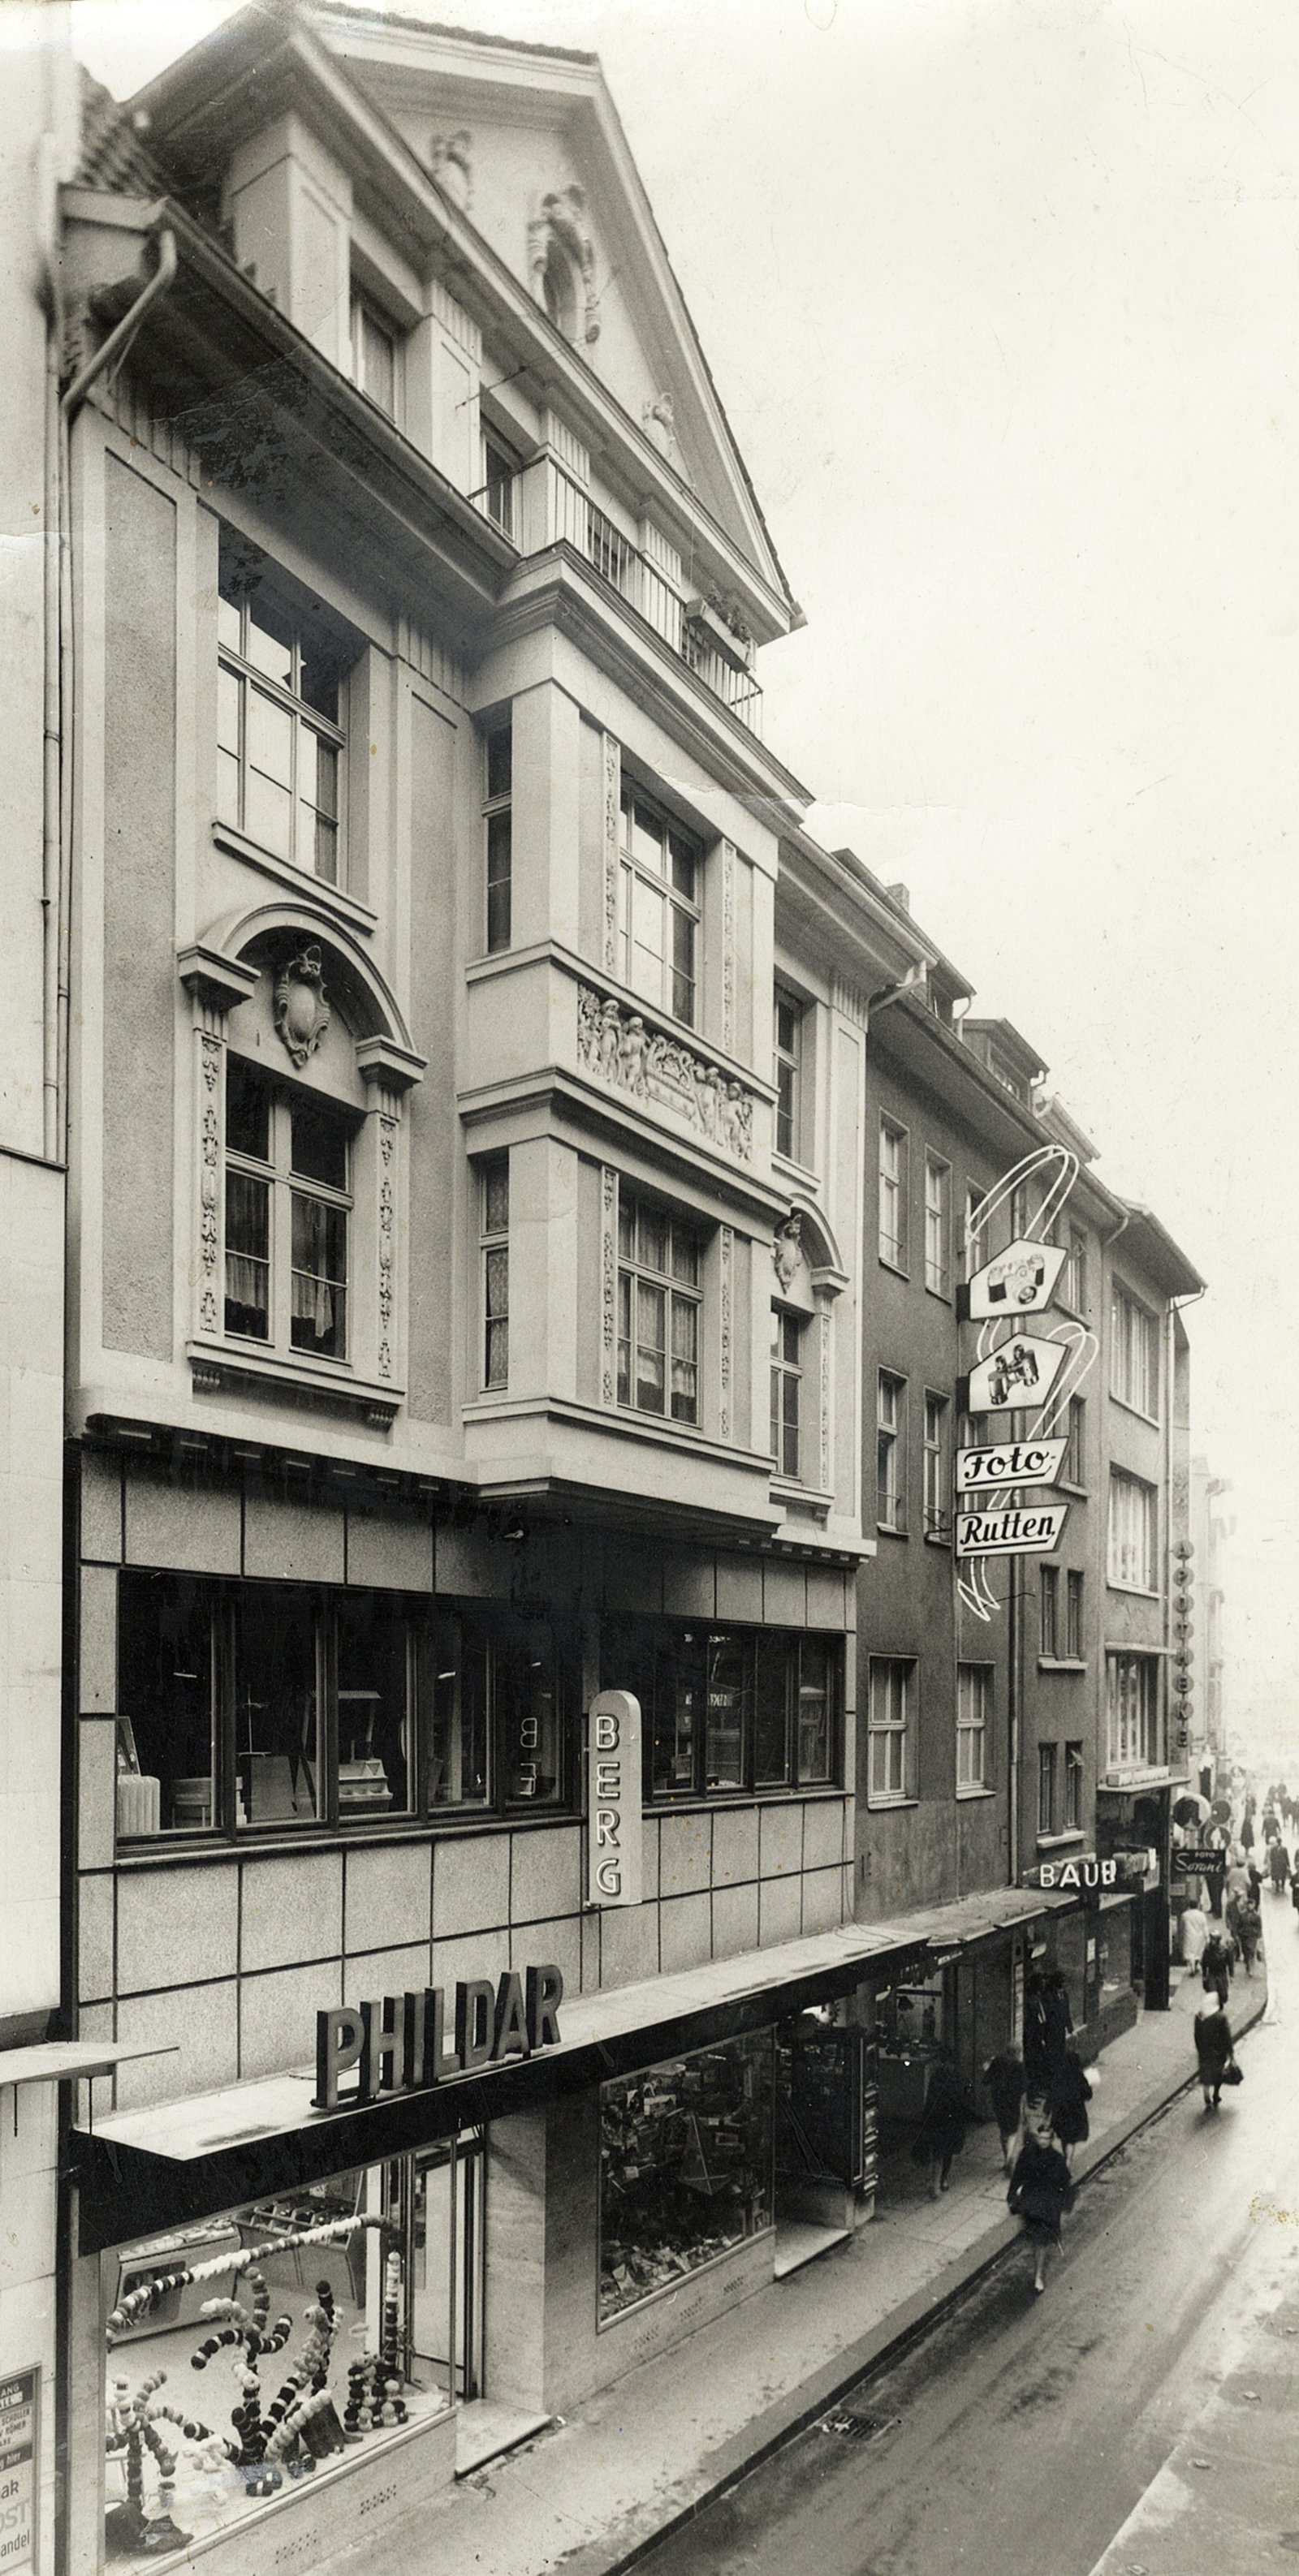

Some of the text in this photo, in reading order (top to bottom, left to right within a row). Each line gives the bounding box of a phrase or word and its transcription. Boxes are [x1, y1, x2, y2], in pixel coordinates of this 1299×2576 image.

[960, 1512, 1055, 1545] Rutten
[596, 1715, 620, 1895] BERG
[1175, 1852, 1223, 1873] Sorani
[316, 1964, 564, 2109] PHILDAR
